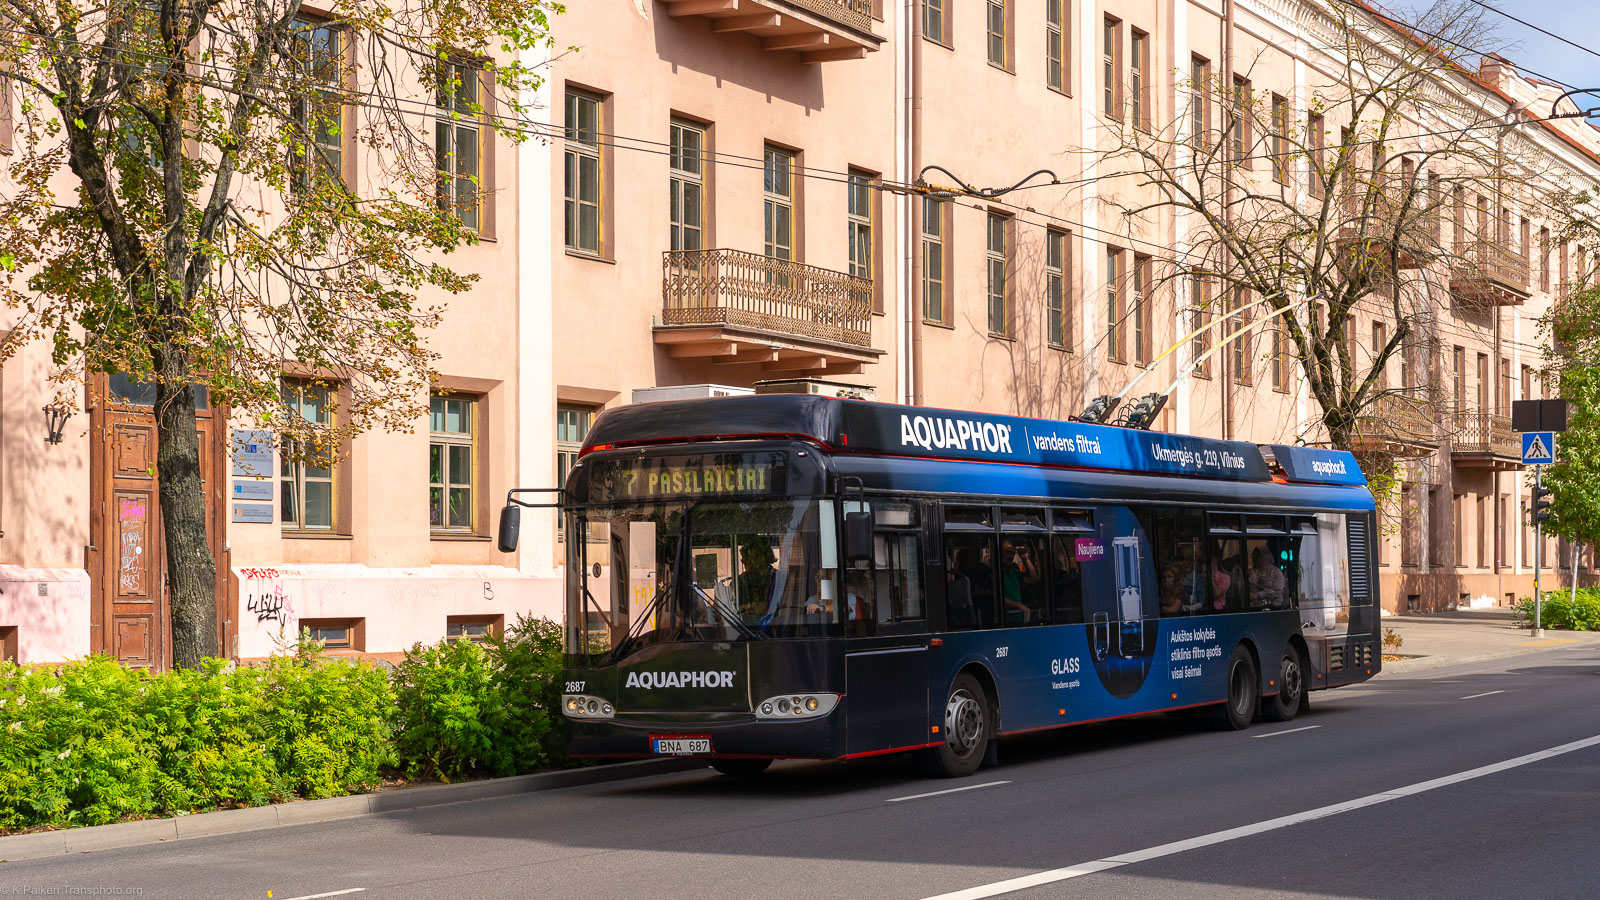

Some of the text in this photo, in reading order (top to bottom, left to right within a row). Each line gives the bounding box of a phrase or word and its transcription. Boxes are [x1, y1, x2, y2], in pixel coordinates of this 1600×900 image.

[900, 415, 1013, 454] AQUAPHOR
[1033, 432, 1101, 455] vandens filtrai
[1151, 443, 1245, 470] Ukmergės g. 219, Vilnius
[1311, 458, 1347, 477] aquaphor.lt
[622, 466, 766, 496] 7 PAŠILAIČIAI
[1077, 542, 1104, 558] Naujiena
[1170, 627, 1216, 643] Aukštos kokybės
[995, 646, 1009, 658] 2687
[1170, 644, 1222, 661] stiklinis filtro ąsotis
[1051, 657, 1080, 675] GLASS
[1170, 664, 1202, 680] visai šeimai
[565, 681, 586, 693] 2687
[625, 671, 734, 689] AQUAPHOR
[1052, 681, 1068, 690] Vandens
[660, 741, 708, 752] BNA 687
